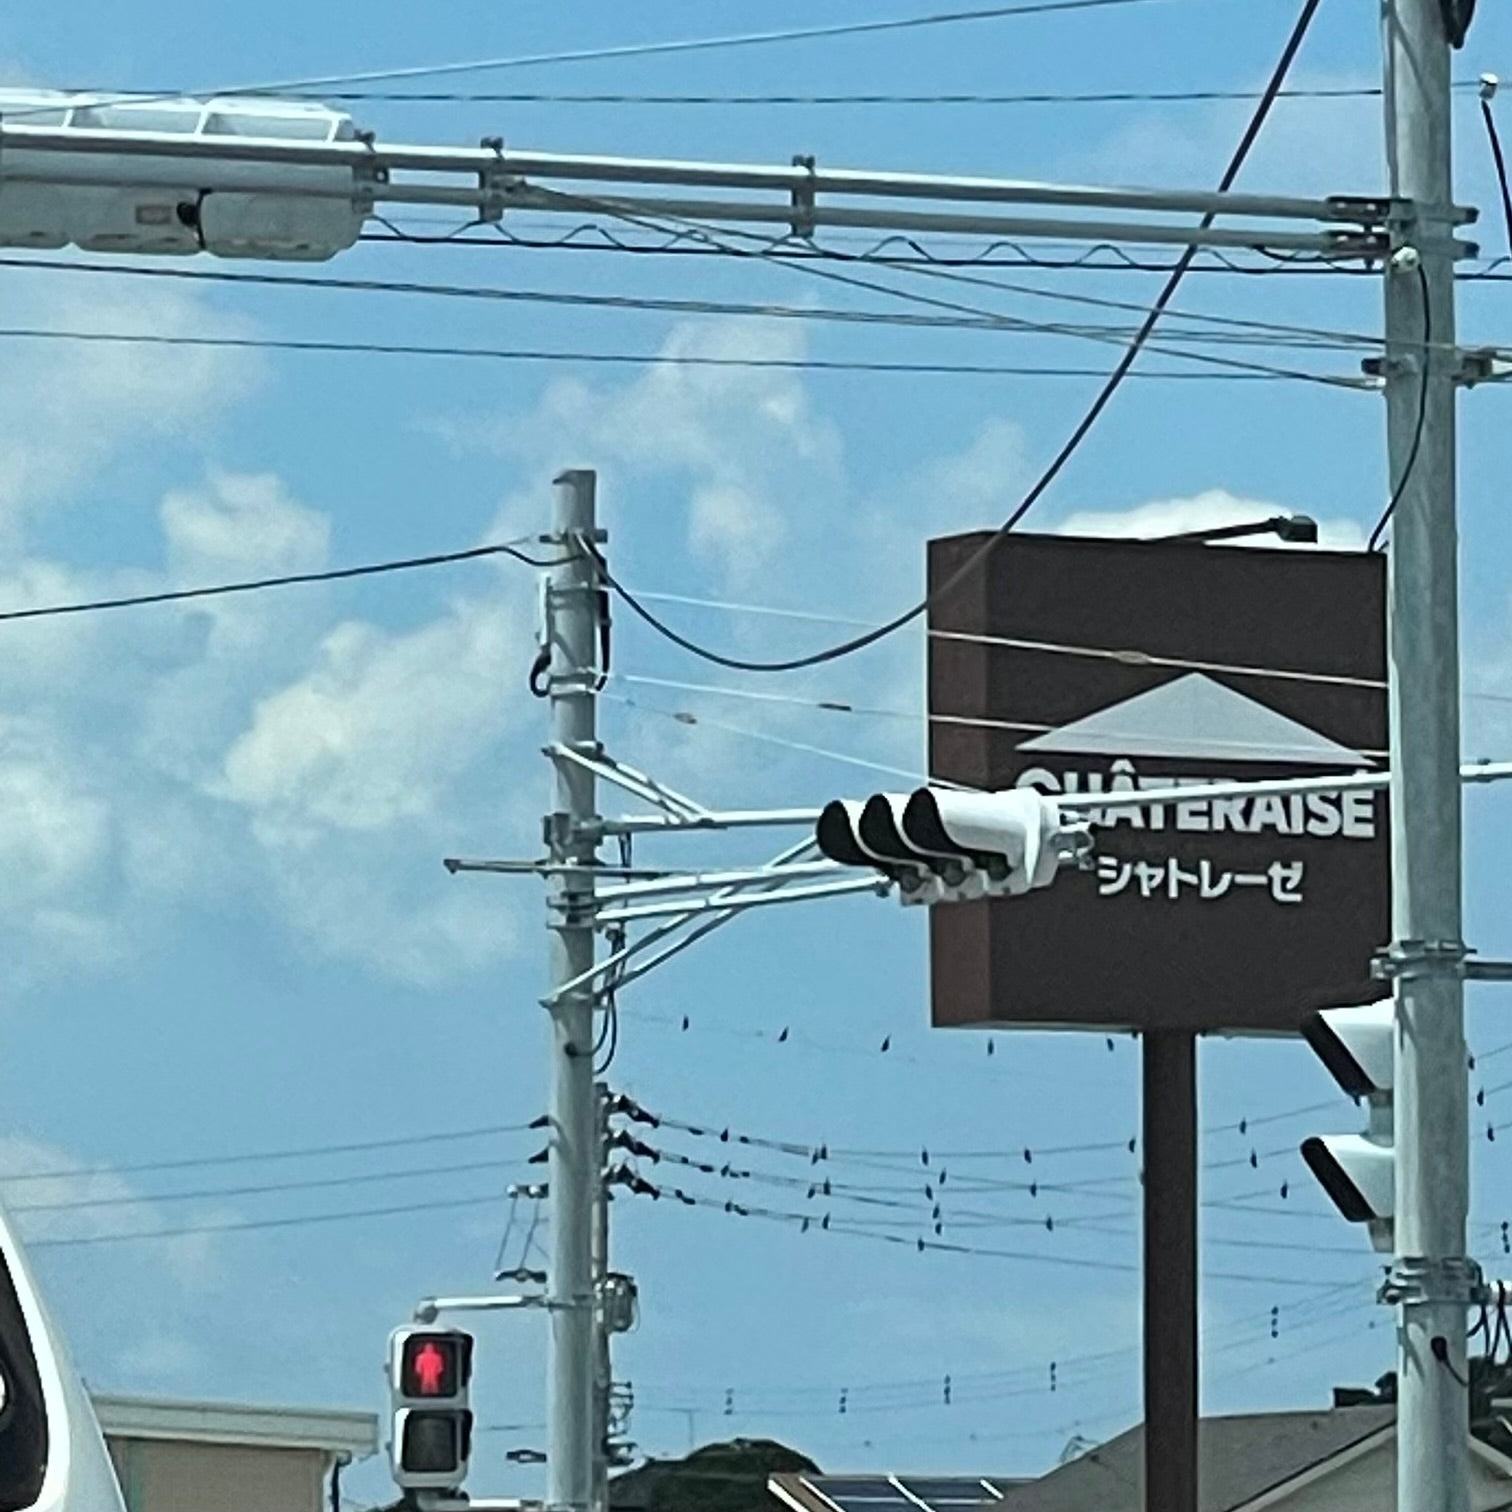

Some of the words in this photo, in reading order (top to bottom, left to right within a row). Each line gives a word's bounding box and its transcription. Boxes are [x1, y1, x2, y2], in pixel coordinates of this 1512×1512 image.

[1098, 855, 1303, 902] シャトレーゼ
